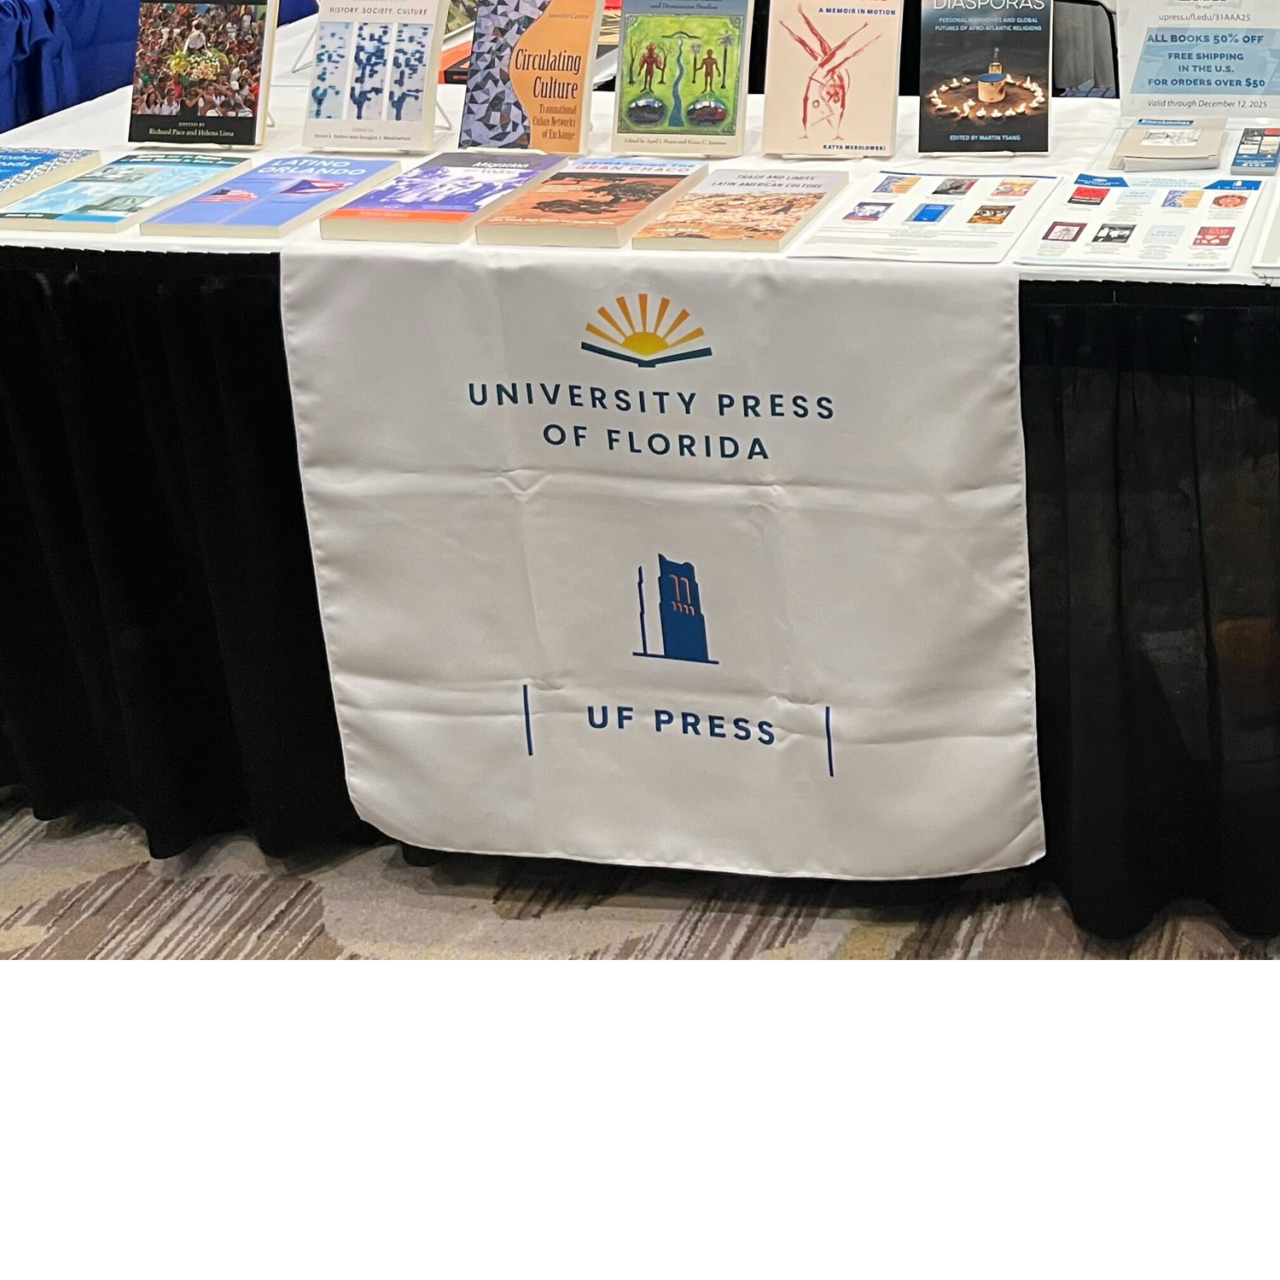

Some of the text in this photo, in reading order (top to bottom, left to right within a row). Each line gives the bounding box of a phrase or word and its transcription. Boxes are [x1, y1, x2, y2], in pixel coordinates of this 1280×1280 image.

[1147, 33, 1264, 44] ALL BOOKS 50% OFF
[515, 48, 582, 75] Circulating
[1168, 52, 1244, 61] FREE SHIPPING
[1214, 65, 1235, 73] U.S.
[533, 76, 578, 99] Culture
[1148, 78, 1168, 86] FOR
[1170, 78, 1212, 86] ORDERS
[1245, 77, 1266, 88] $50
[539, 103, 577, 115] Transnational
[1148, 99, 1268, 109] Valid through December 2025
[148, 127, 171, 135] Richard
[271, 159, 351, 168] LATINO
[258, 166, 367, 176] ORLANDO
[468, 382, 834, 420] UNIVERSITY PRESS
[543, 423, 769, 460] OF FLORIDA
[587, 705, 778, 746] UF PRESS
